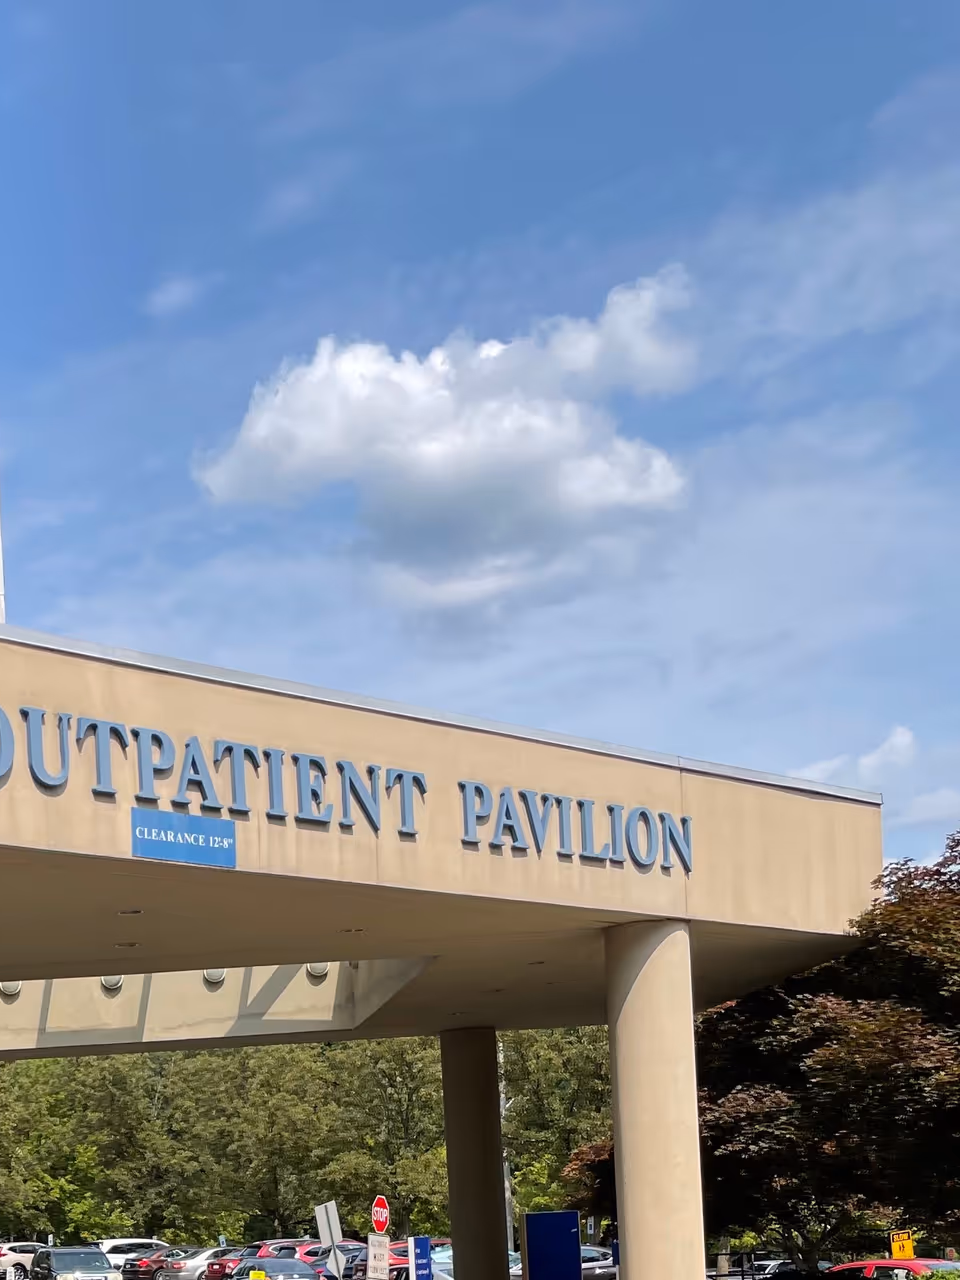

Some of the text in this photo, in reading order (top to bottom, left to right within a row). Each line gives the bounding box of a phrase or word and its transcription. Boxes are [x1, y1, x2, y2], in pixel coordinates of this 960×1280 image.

[135, 826, 206, 846] CLEARANCE
[457, 780, 693, 874] PAVILION
[373, 1206, 388, 1222] STOP
[893, 1232, 909, 1242] SLOW
